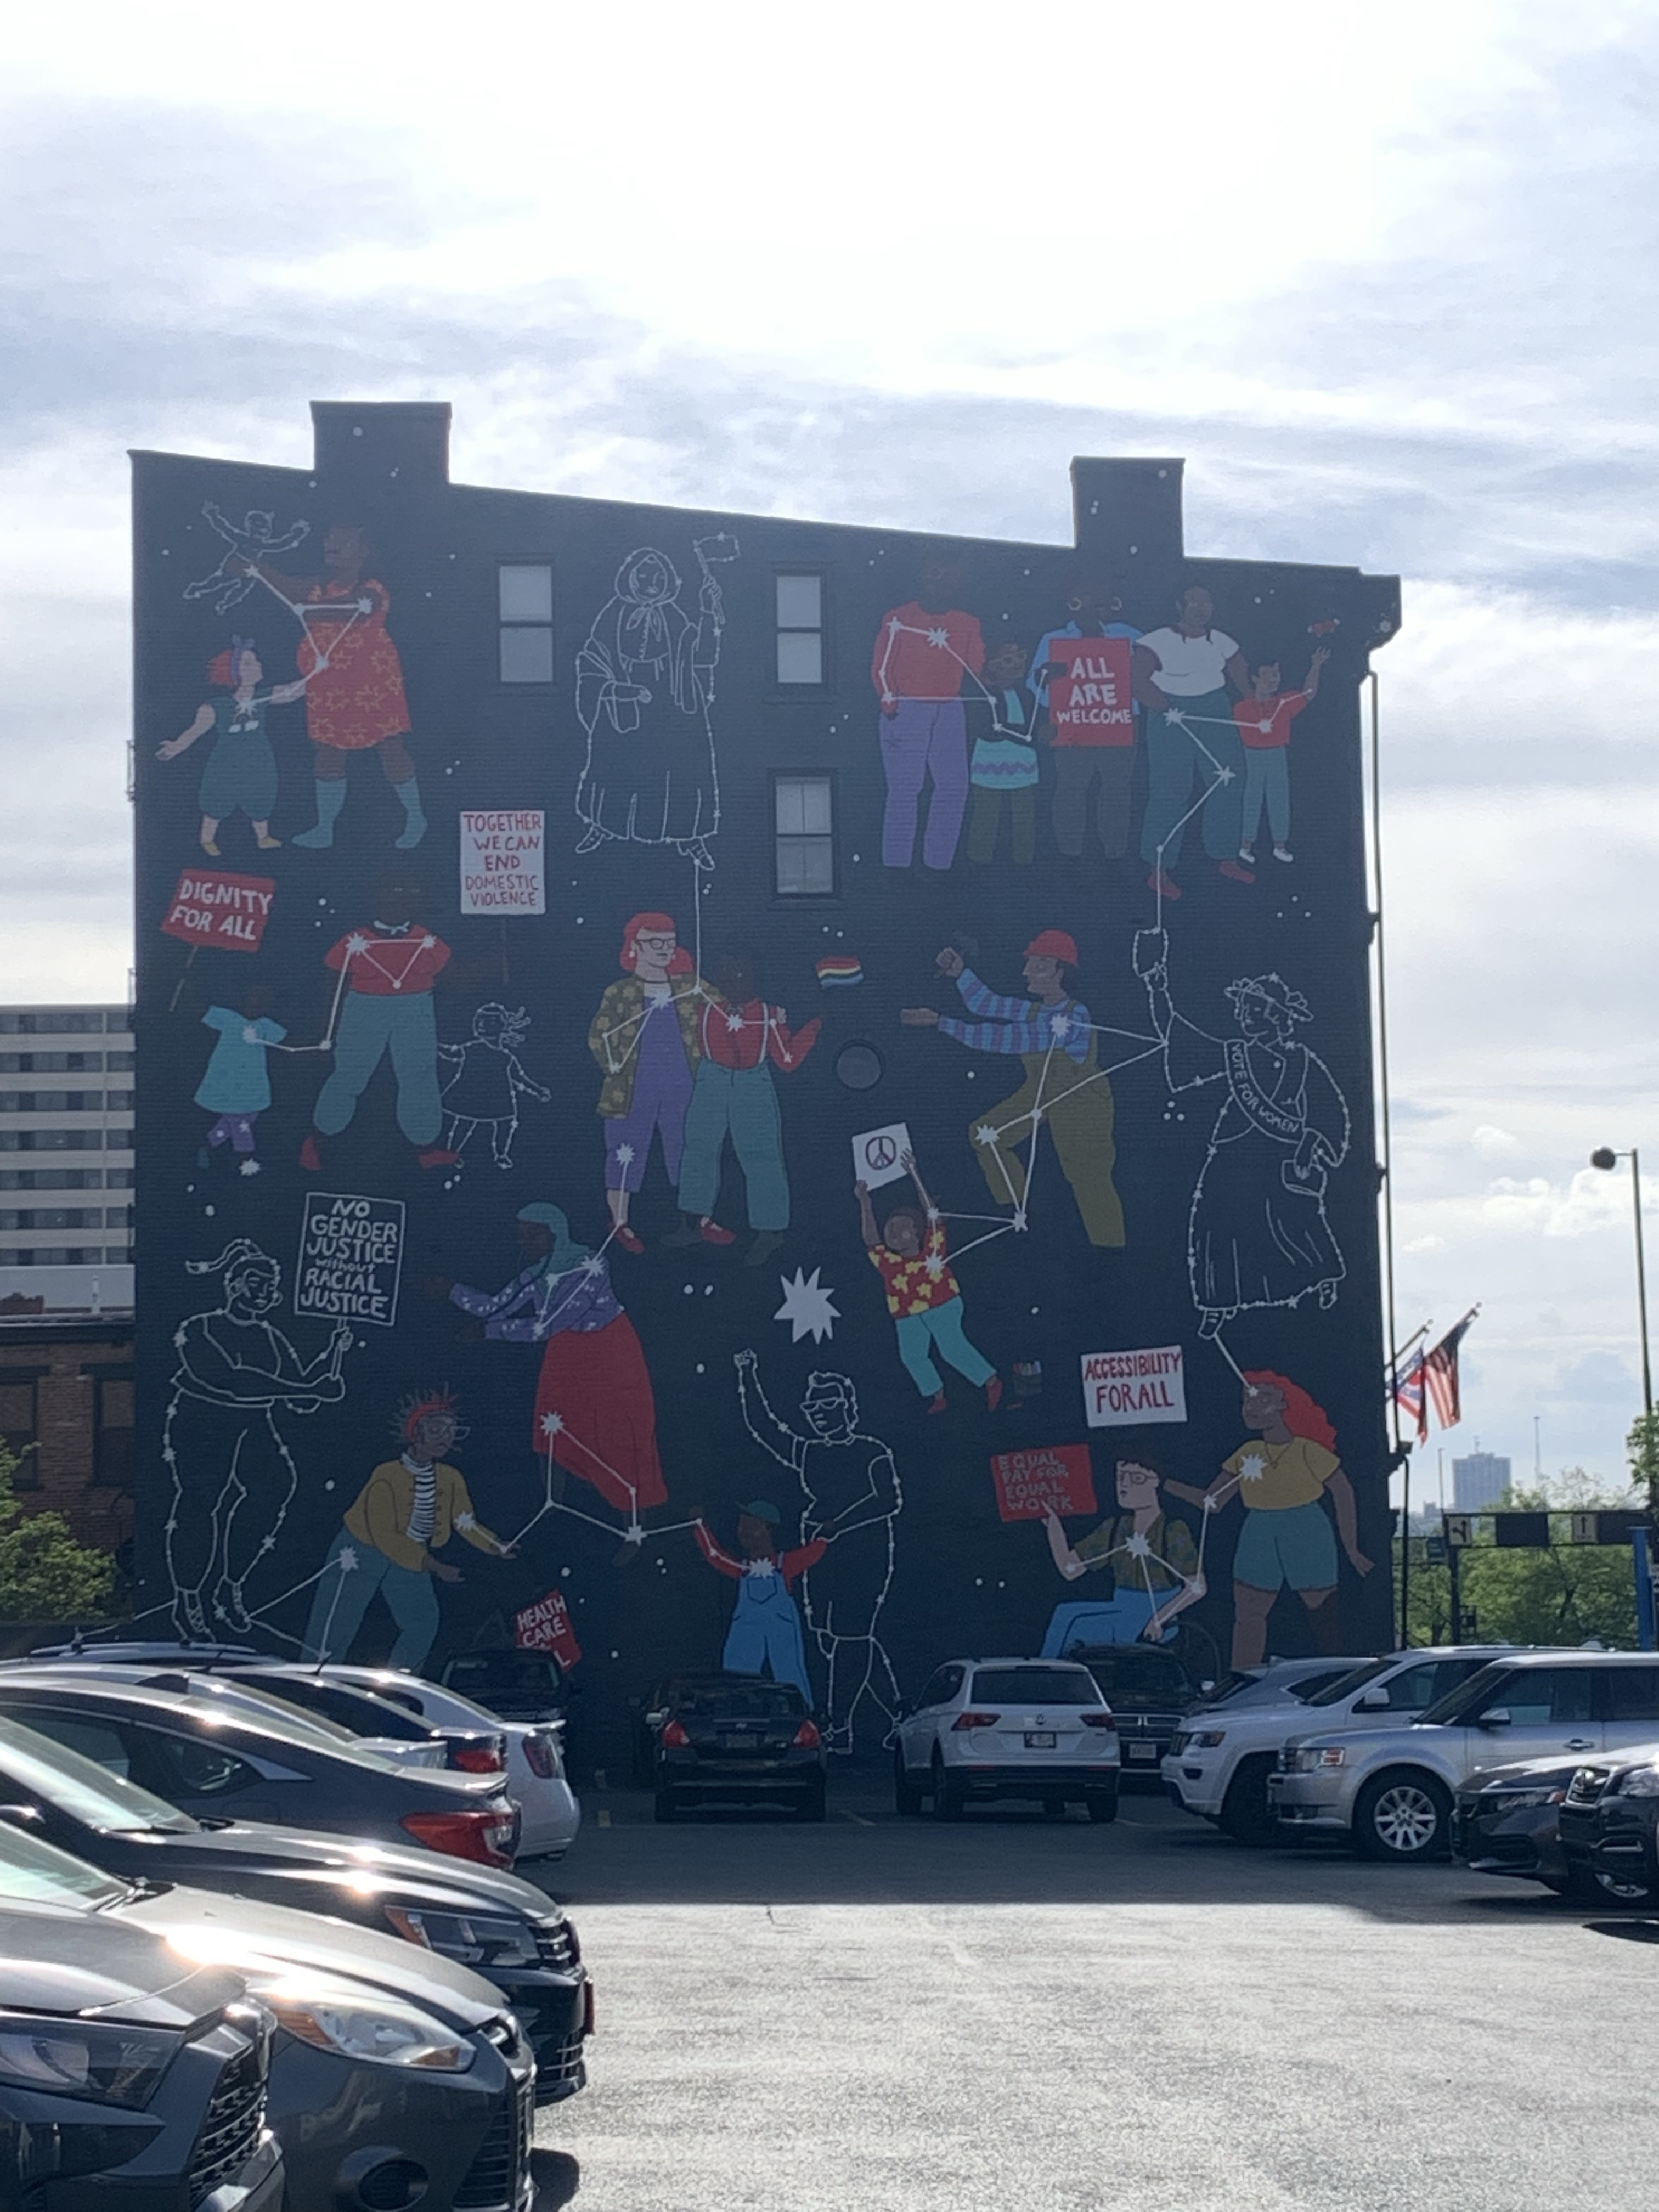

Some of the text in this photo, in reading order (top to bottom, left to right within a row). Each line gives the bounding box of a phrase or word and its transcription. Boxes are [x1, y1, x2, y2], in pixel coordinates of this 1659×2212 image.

[1071, 657, 1115, 679] ALL
[1070, 683, 1118, 707] ARE
[1057, 708, 1132, 724] WELCOME
[463, 812, 541, 832] TOGETHER
[473, 836, 540, 851] WE CAN
[484, 854, 520, 871] END
[466, 874, 539, 891] DOMESTIC
[179, 879, 273, 915] DIGNITY
[470, 891, 536, 906] VIOLENCE
[171, 905, 256, 940] FOR ALL
[1232, 1043, 1299, 1133] VOTE FOR WOMEN
[331, 1199, 370, 1217] NO
[311, 1214, 397, 1243] GENDER
[306, 1237, 396, 1263] JUSTICE
[315, 1257, 375, 1273] without
[304, 1267, 382, 1294] RACIAL
[300, 1286, 389, 1318] JUSTICE
[1085, 1352, 1182, 1381] ACCESSIBILITY
[1096, 1380, 1175, 1413] FOR ALL
[998, 1450, 1059, 1470] EQUAL
[1002, 1464, 1069, 1484] PAY FOR
[1006, 1479, 1064, 1499] EQUAL
[1007, 1495, 1074, 1510] WORK
[517, 1594, 567, 1632] HEALTH
[523, 1615, 566, 1646] CARE
